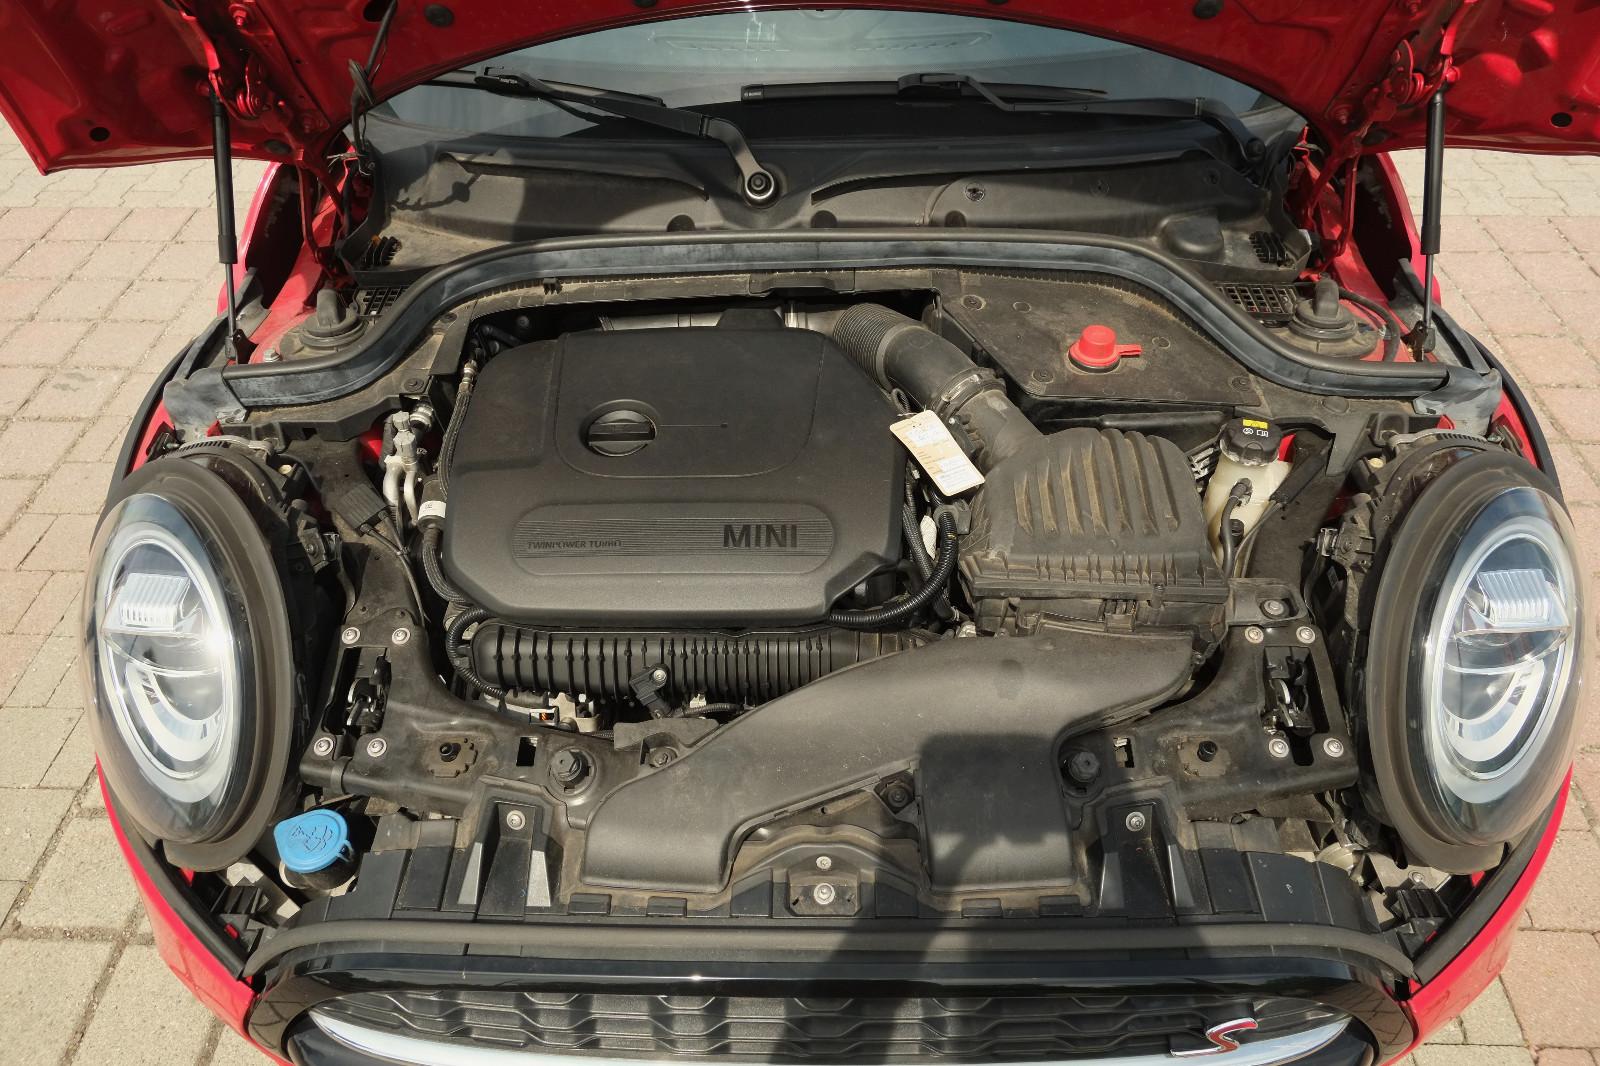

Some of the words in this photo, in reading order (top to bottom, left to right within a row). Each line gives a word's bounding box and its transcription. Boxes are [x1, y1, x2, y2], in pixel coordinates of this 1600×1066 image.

[527, 539, 586, 550] TWINPOWER
[723, 524, 798, 548] MINI
[1170, 1018, 1258, 1057] S
